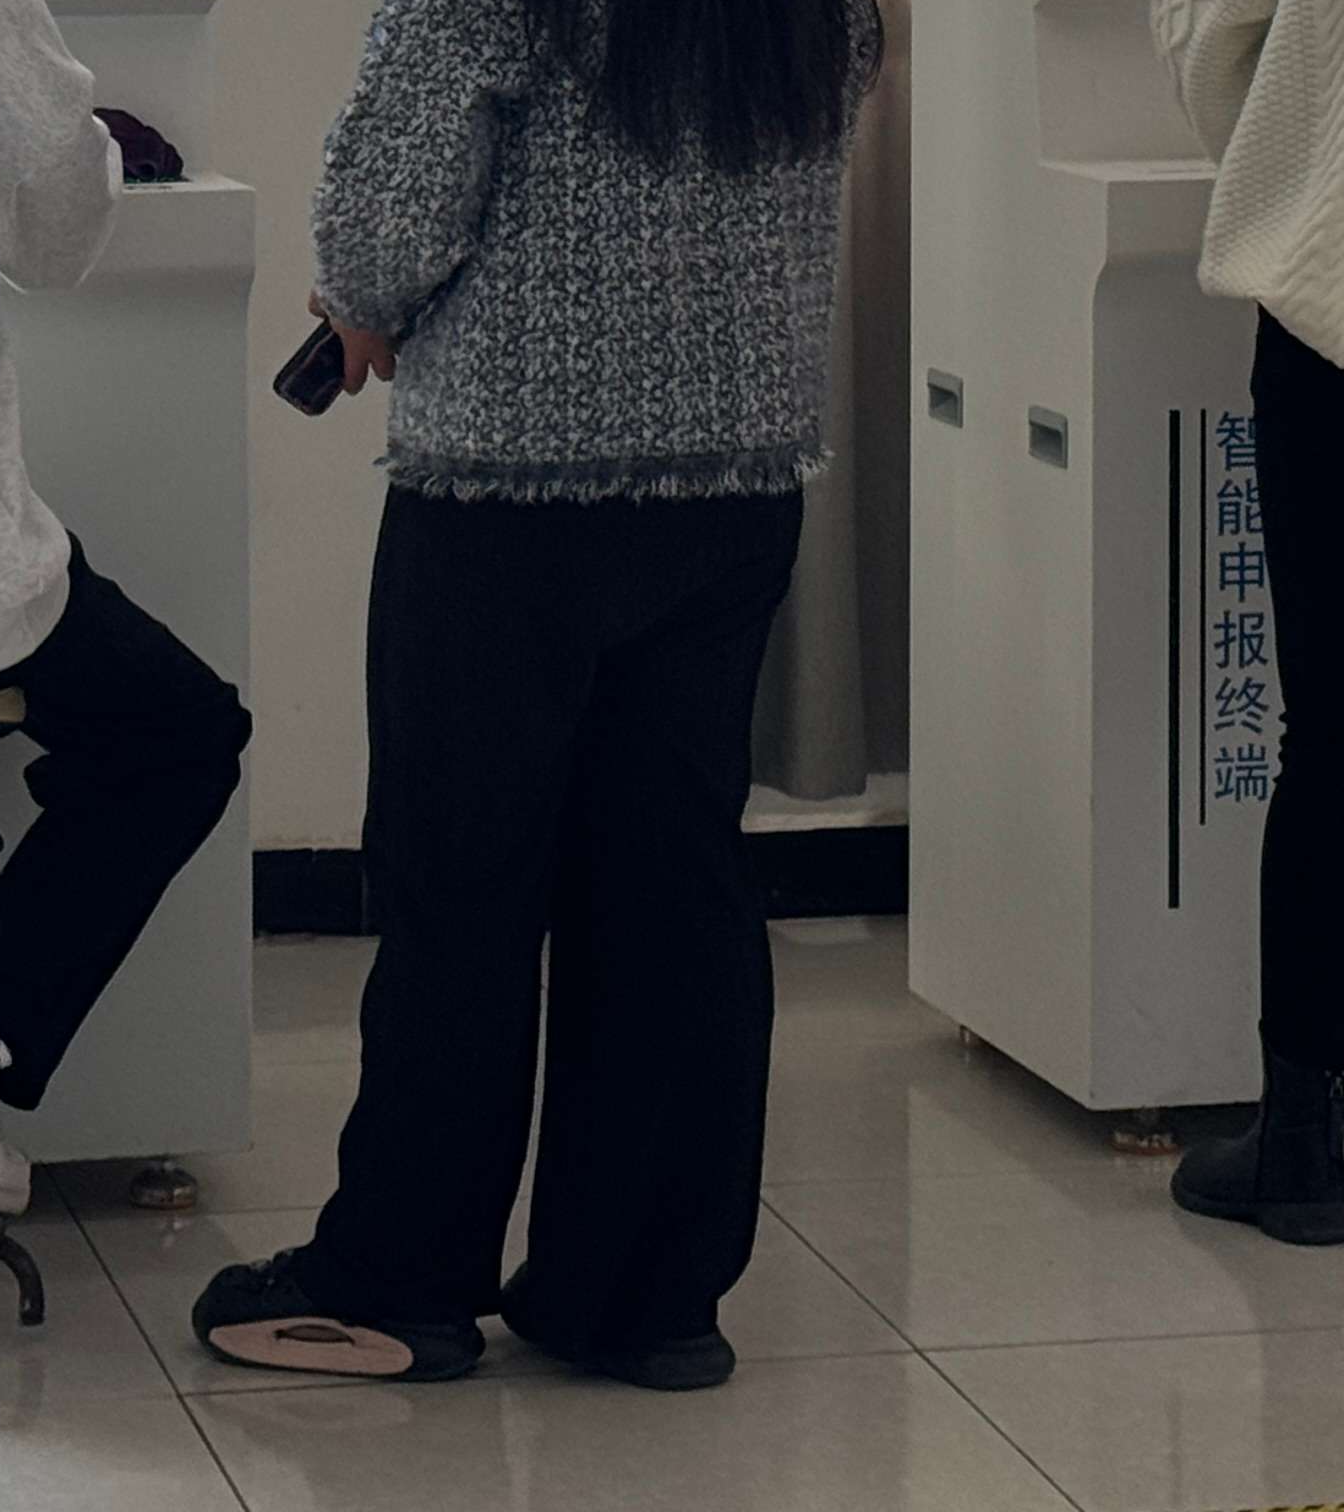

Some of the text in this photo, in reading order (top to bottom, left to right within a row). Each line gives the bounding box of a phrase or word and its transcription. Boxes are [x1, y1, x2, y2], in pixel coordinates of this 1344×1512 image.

[1212, 410, 1270, 803] 智能申报终端
